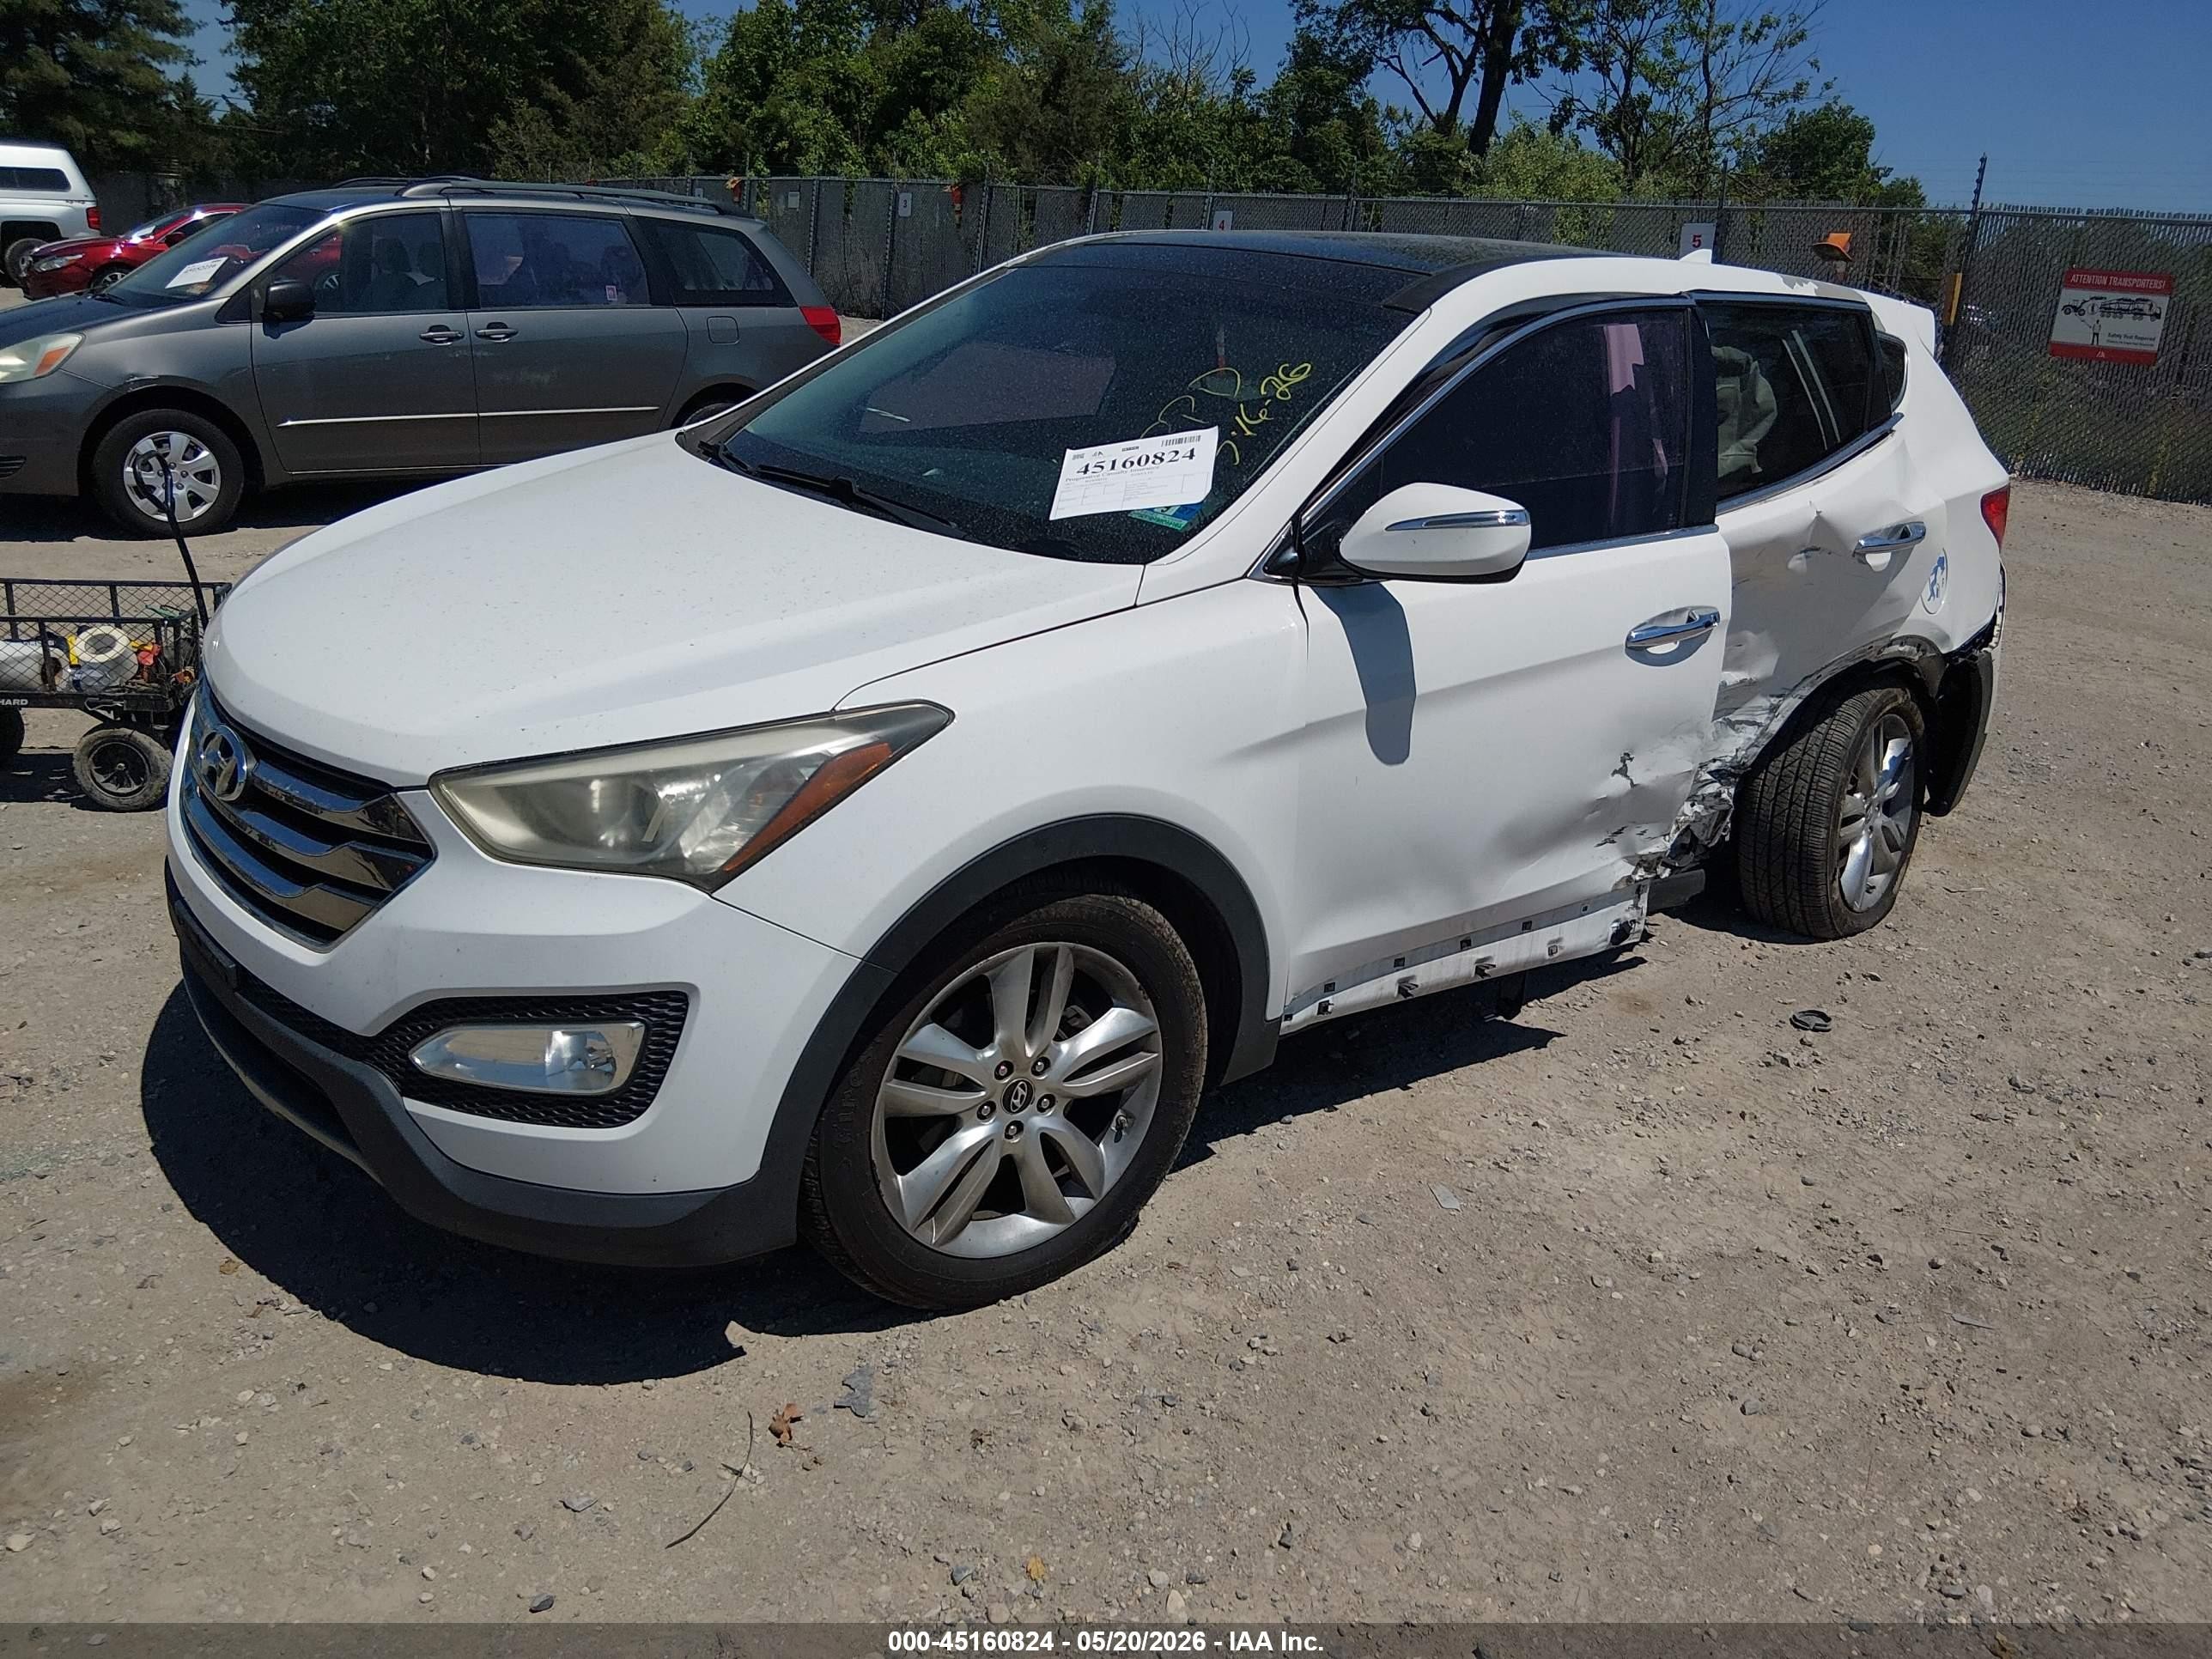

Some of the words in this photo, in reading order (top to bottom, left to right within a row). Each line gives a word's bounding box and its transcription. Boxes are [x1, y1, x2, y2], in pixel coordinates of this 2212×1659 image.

[1218, 219, 1225, 231] 4
[1692, 234, 1702, 248] 5
[2070, 273, 2108, 286] ATTENTION
[2108, 276, 2166, 290] TRANSPORTERS!
[1076, 447, 1196, 476] 45160824
